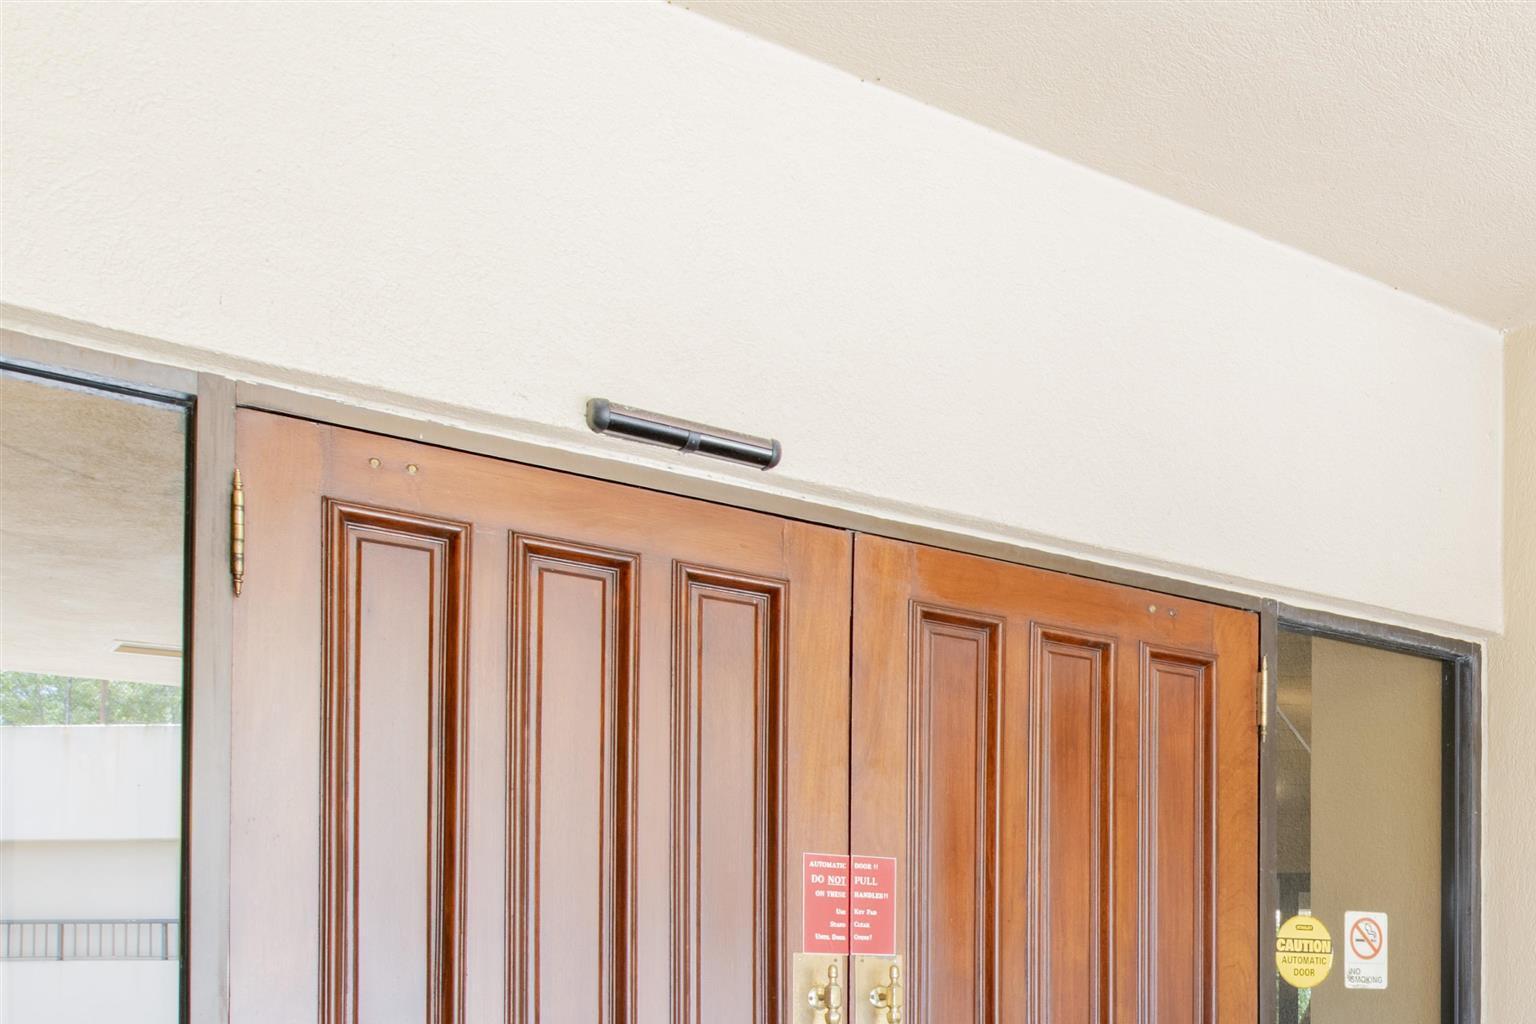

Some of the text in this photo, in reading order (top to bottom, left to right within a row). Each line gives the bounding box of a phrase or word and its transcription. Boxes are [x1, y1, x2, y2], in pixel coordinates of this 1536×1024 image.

[811, 874, 878, 886] DO NOT PULL
[826, 890, 847, 898] THESE
[1276, 938, 1331, 953] CAUTION
[1282, 956, 1327, 965] AUTOMATIC
[1293, 968, 1315, 976] DOOR
[1350, 967, 1361, 975] NO
[1350, 975, 1383, 984] SMOKING
